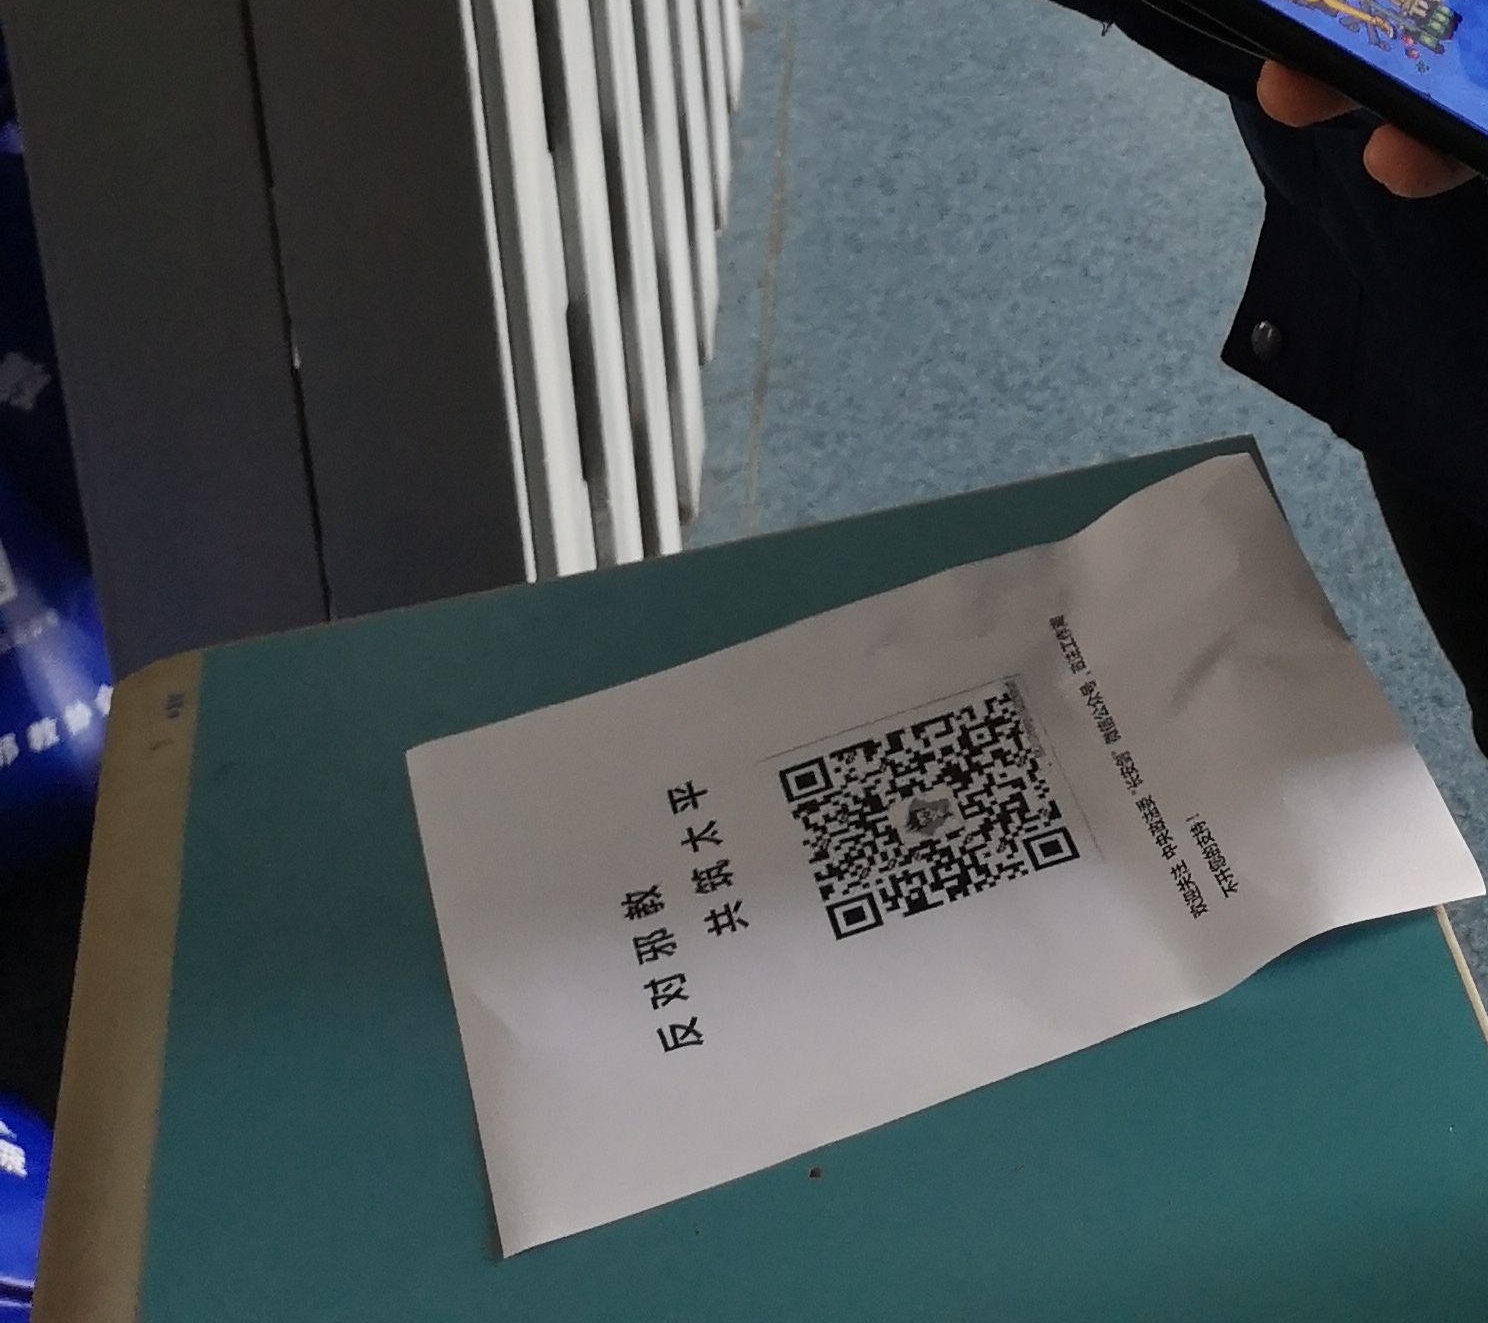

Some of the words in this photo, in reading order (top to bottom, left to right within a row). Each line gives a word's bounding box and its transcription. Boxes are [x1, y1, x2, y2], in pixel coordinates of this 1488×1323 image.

[667, 779, 750, 937] 共筑太平
[621, 884, 706, 1052] 反对邪教
